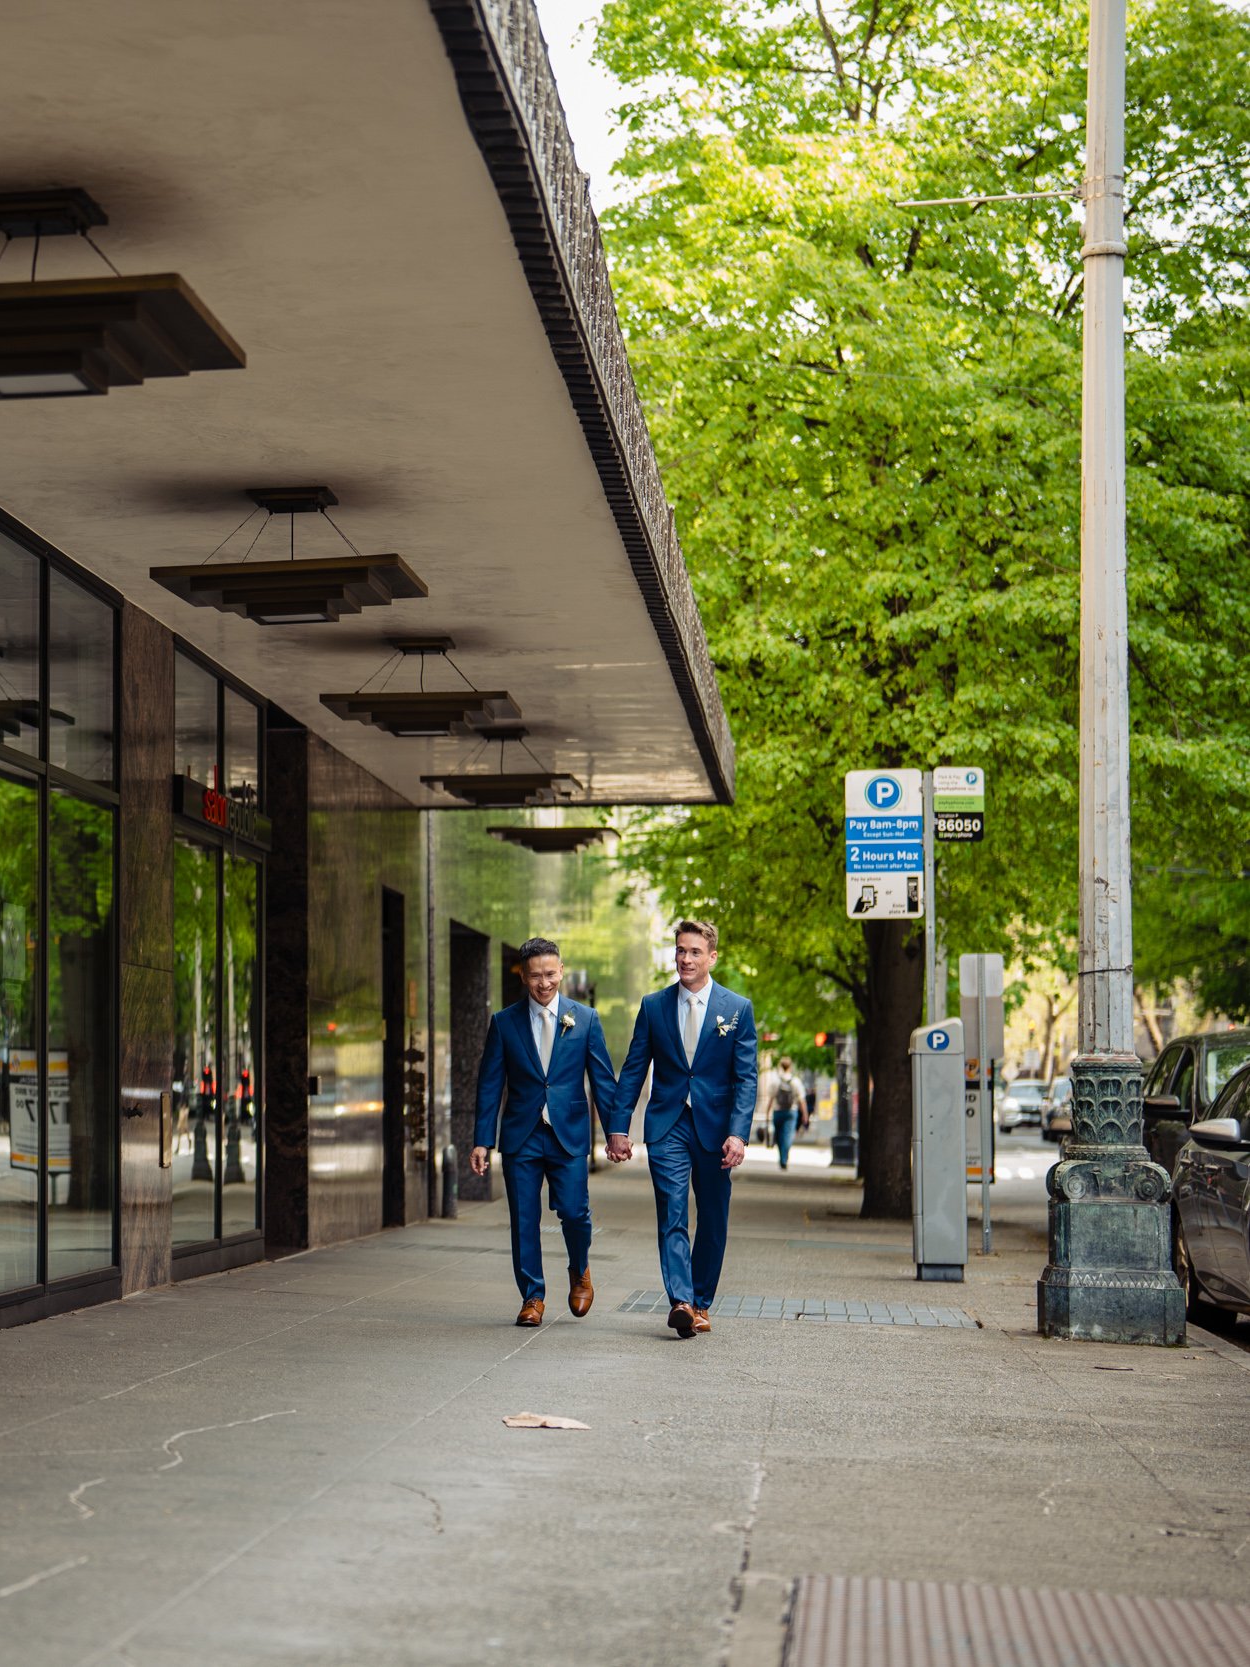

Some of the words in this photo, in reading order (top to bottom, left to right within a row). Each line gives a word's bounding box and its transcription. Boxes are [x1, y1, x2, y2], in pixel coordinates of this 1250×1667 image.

[849, 820, 868, 832] Pay
[870, 818, 919, 831] 8am-8pm
[938, 818, 981, 832] 86050
[863, 831, 882, 839] Except
[850, 846, 860, 862] 2
[862, 850, 895, 862] Hours
[897, 850, 919, 861] Max
